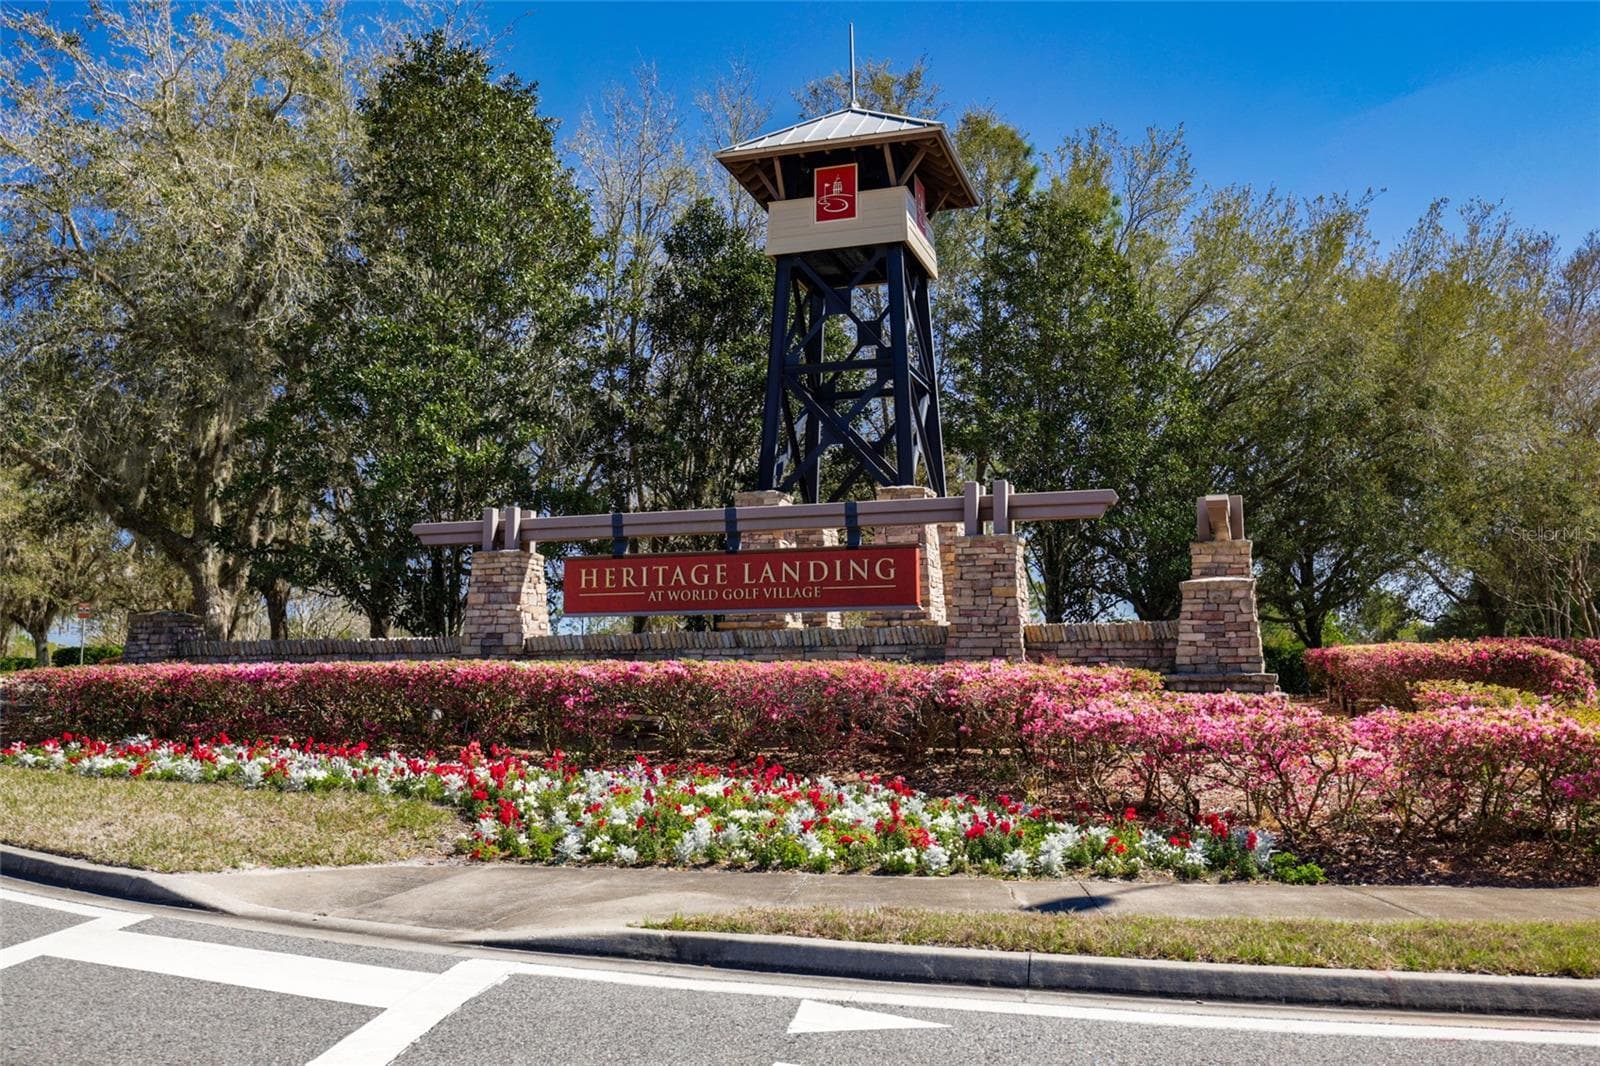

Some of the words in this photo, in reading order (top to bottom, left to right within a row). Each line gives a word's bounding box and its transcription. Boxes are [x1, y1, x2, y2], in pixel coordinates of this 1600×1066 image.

[580, 563, 727, 589] HERITAGE
[743, 557, 896, 583] LANDING
[648, 590, 665, 602] AT
[668, 588, 718, 602] WORLD
[722, 587, 759, 600] GOLF
[763, 585, 821, 599] VILLAGE
